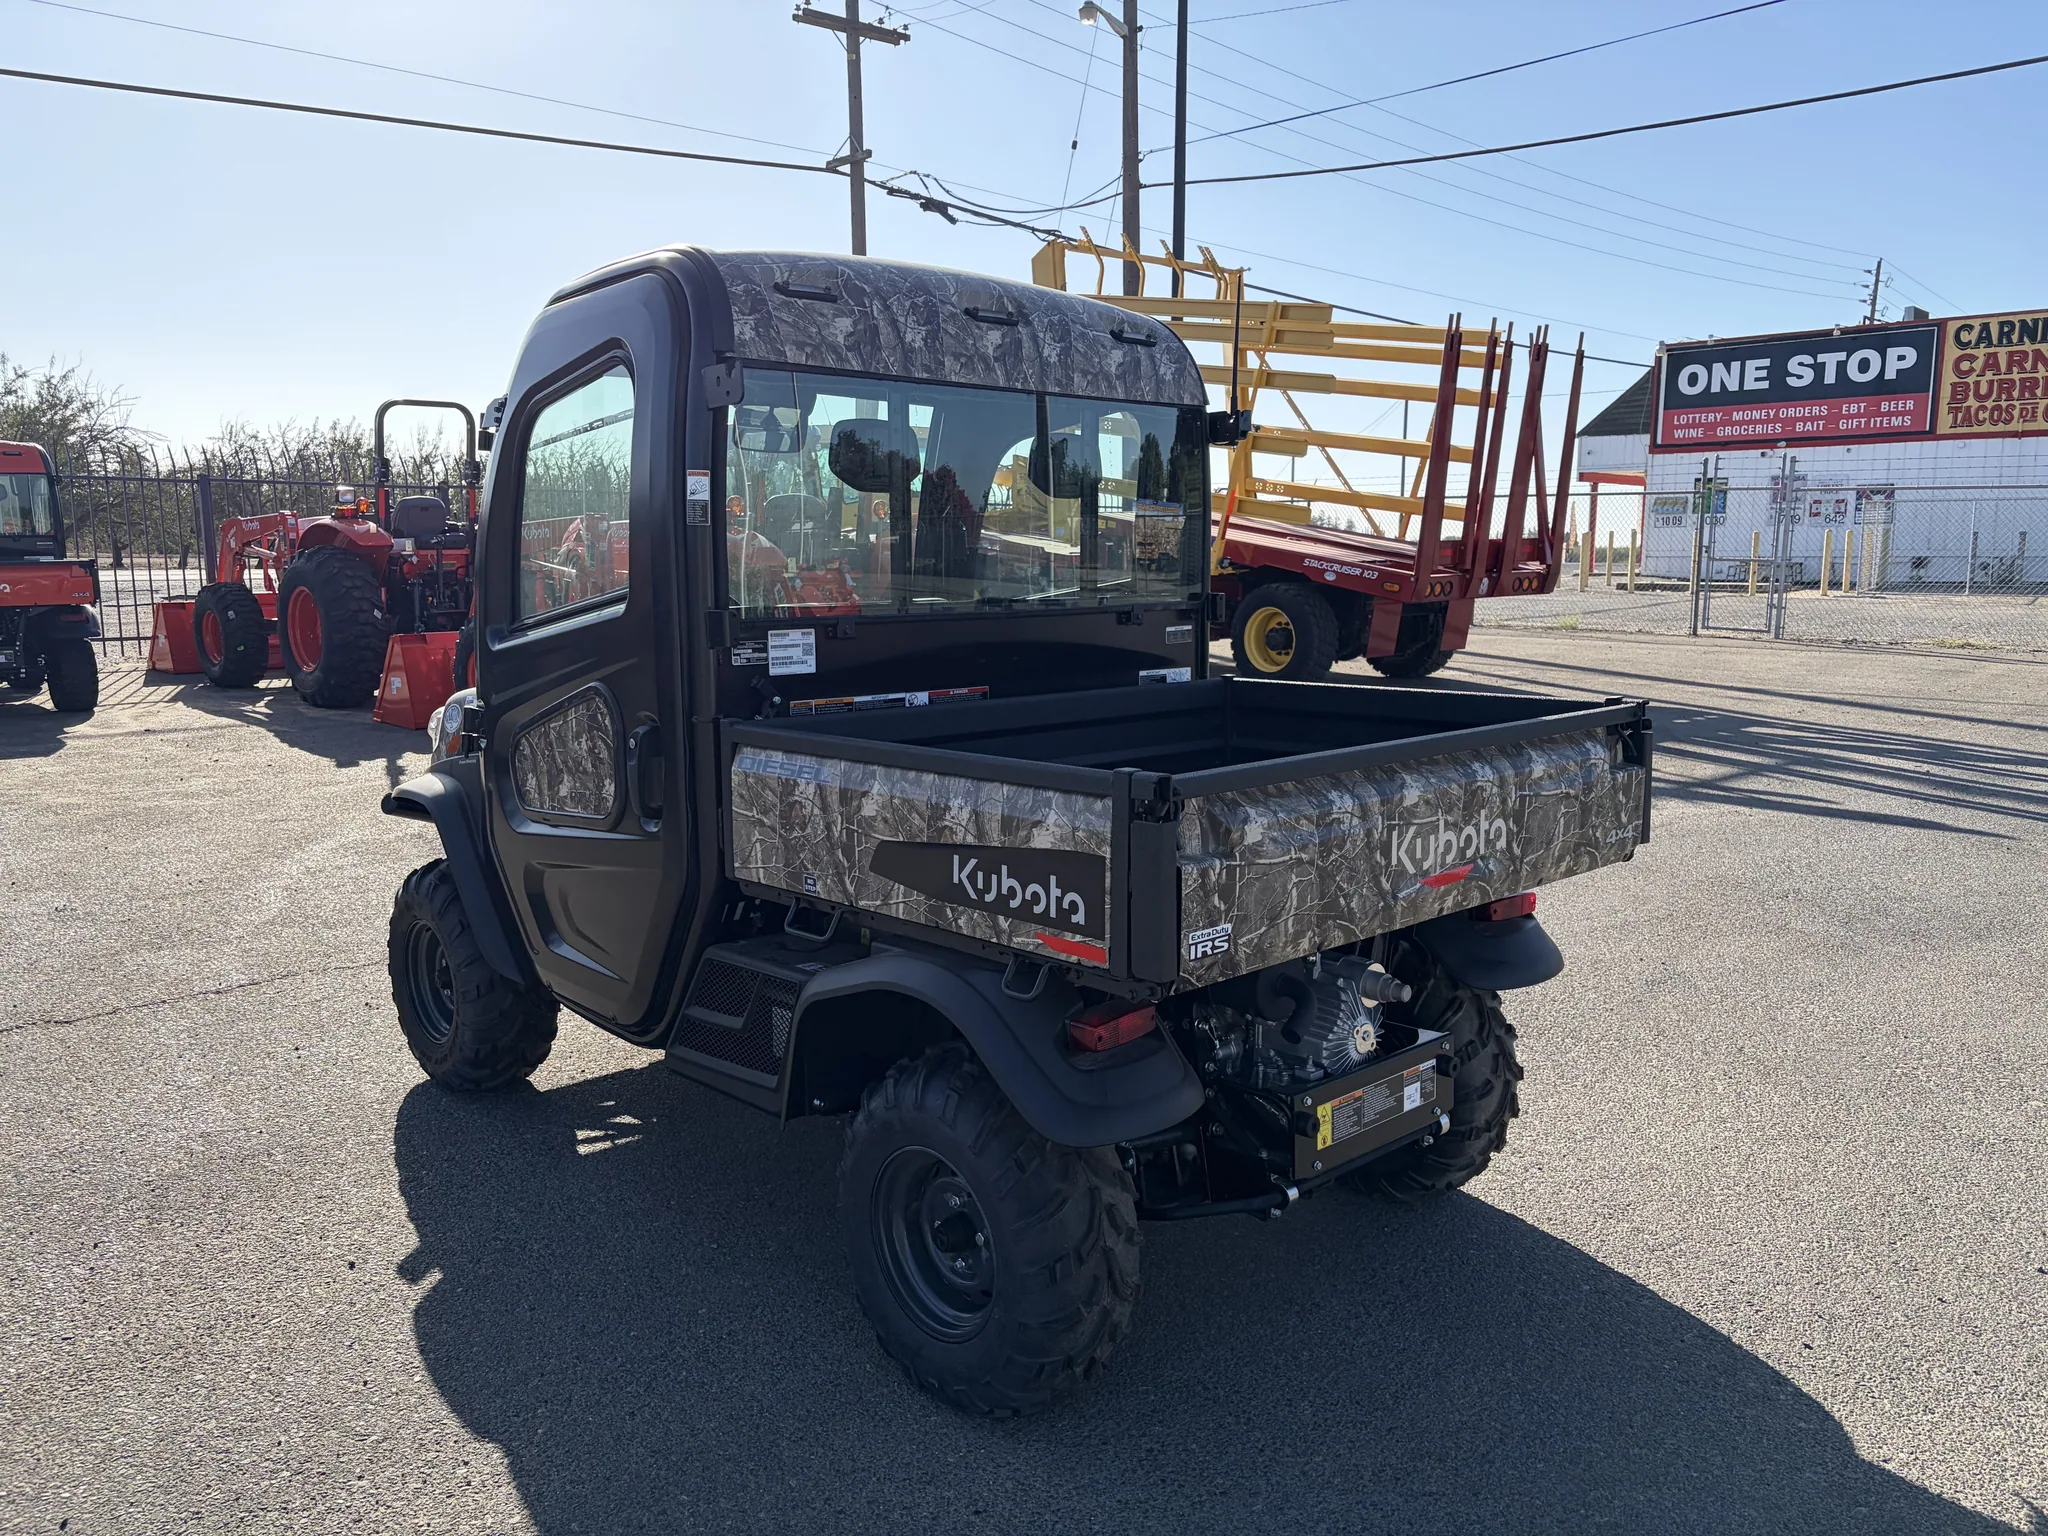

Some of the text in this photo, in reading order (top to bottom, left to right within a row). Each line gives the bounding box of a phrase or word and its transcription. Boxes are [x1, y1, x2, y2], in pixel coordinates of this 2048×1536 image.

[1677, 346, 1918, 396] ONE STOP
[1732, 409, 1776, 422] MONEY
[1779, 405, 1828, 418] ORDERS
[1842, 403, 1867, 415] EBT
[1880, 400, 1914, 412] BEER
[1947, 403, 2017, 428] TACOS
[2019, 405, 2039, 420] DE
[1673, 427, 1704, 439] WINE
[1716, 423, 1782, 437] GROCERIES
[1795, 420, 1826, 433] BAIT
[1838, 418, 1867, 430] GIFT
[1870, 415, 1912, 428] ITEMS
[522, 525, 550, 540] Kubota
[1303, 558, 1362, 576] STACKCRUISER
[1363, 570, 1379, 580] 103
[733, 756, 832, 784] DIESEL
[1391, 808, 1507, 874] Kubota
[1606, 825, 1635, 845] 4x4
[805, 884, 816, 892] STEP
[953, 854, 1085, 926] Kubota
[1191, 926, 1229, 941] Extra Duty
[1190, 936, 1229, 960] IRS
